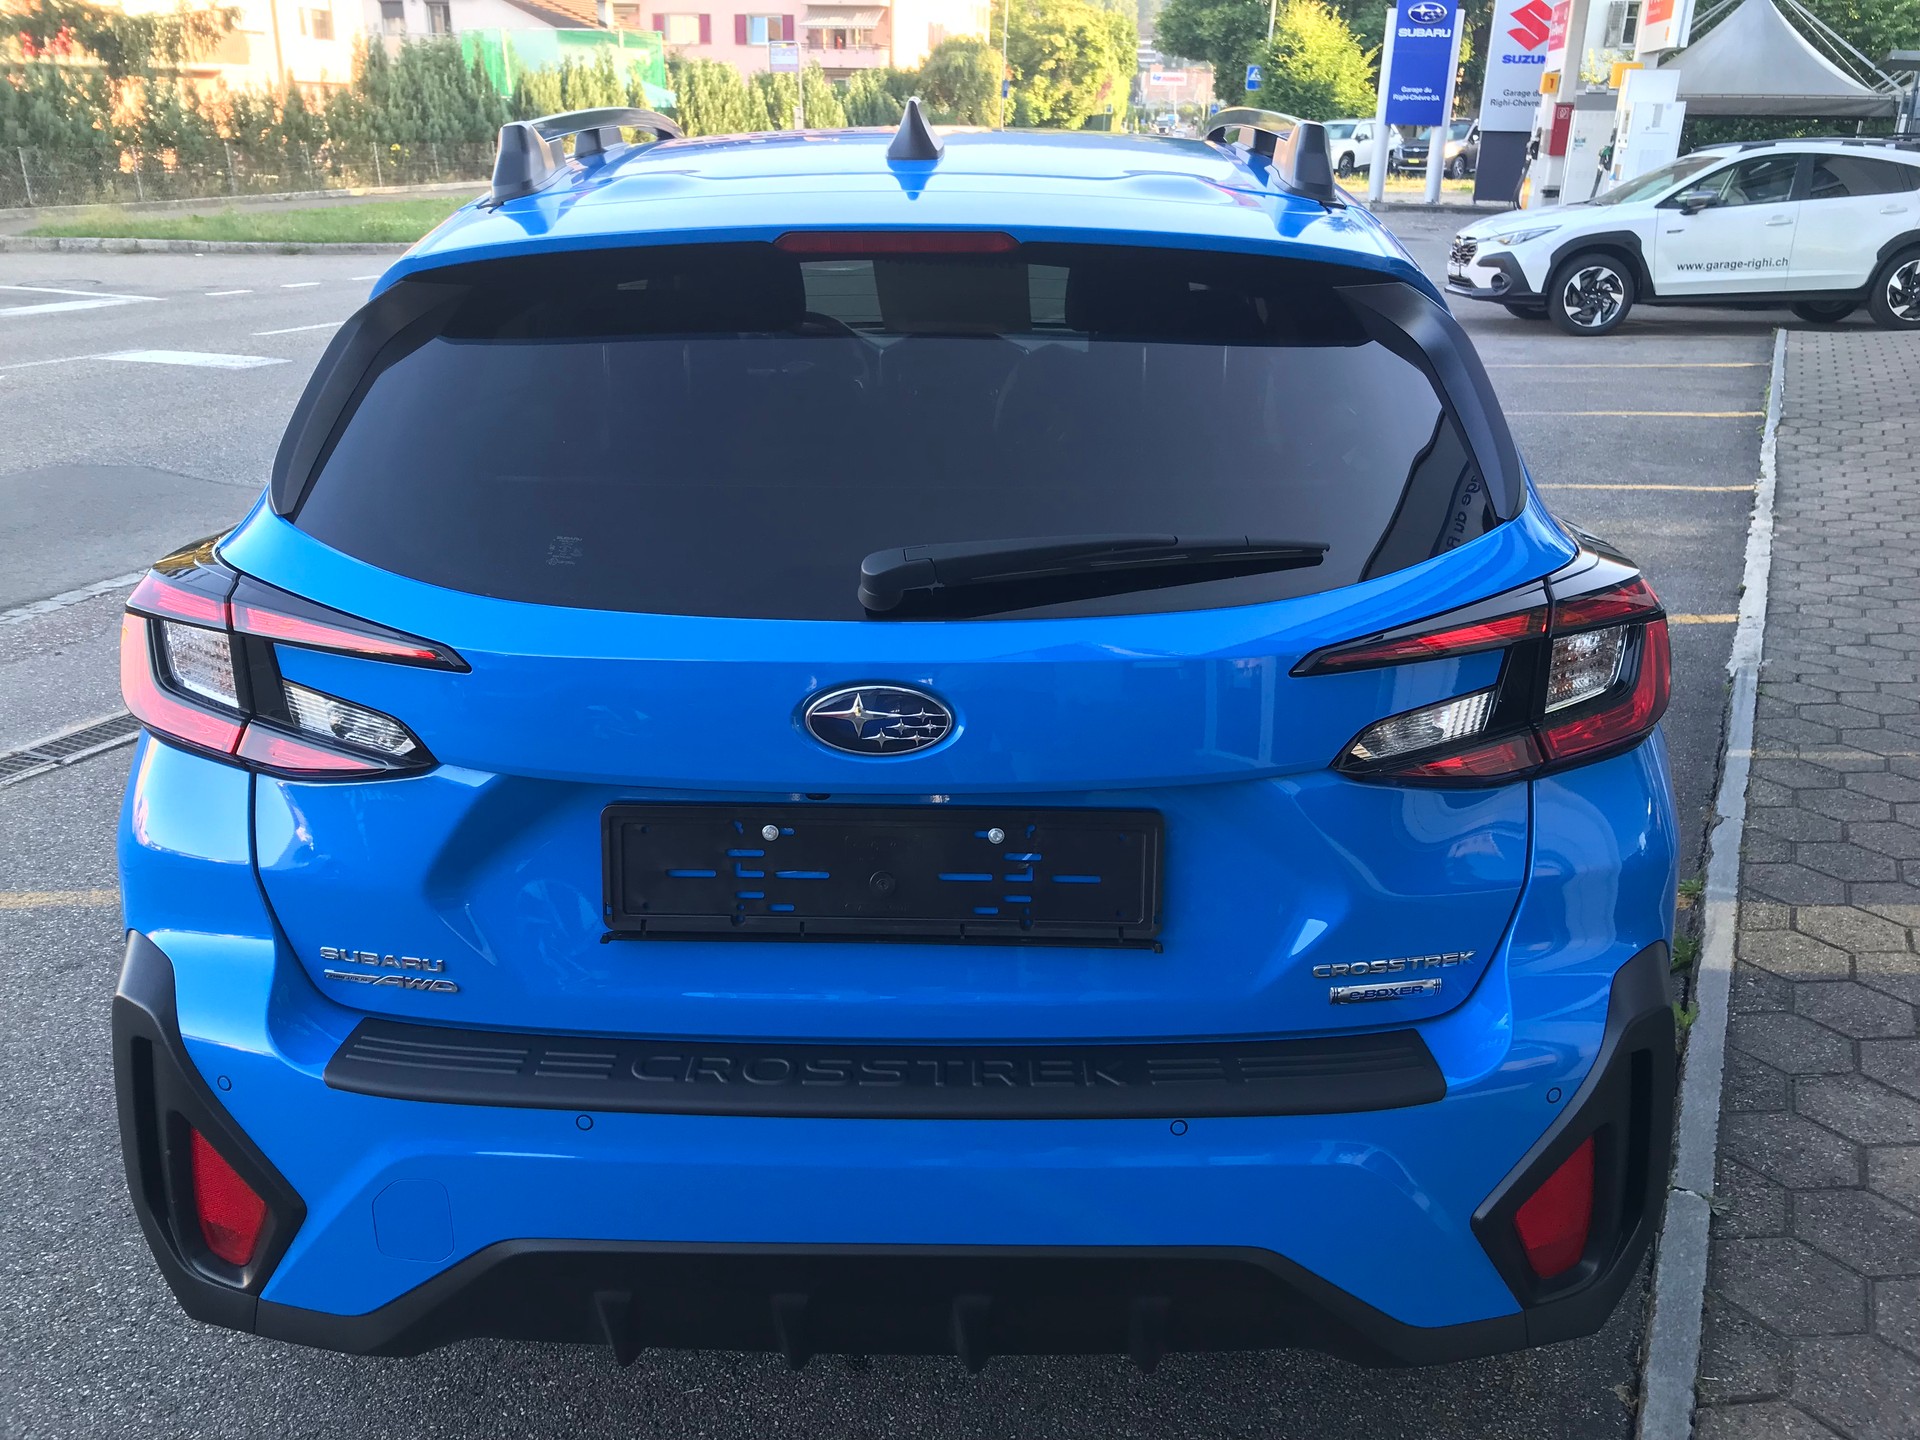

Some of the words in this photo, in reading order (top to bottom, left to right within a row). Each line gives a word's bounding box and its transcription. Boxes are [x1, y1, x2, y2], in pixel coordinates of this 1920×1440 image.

[1398, 28, 1451, 38] SUBARU
[1401, 86, 1423, 94] Garage
[1550, 78, 1554, 88] 1
[1503, 89, 1531, 98] Garage
[1677, 257, 1789, 272] www.garage-righi.ch
[320, 946, 445, 973] SUBARU
[1312, 950, 1477, 978] CROSSTREK
[373, 975, 459, 993] AWD
[1350, 985, 1424, 1000] e-BOXER
[631, 1055, 1126, 1089] CROSSTREK
